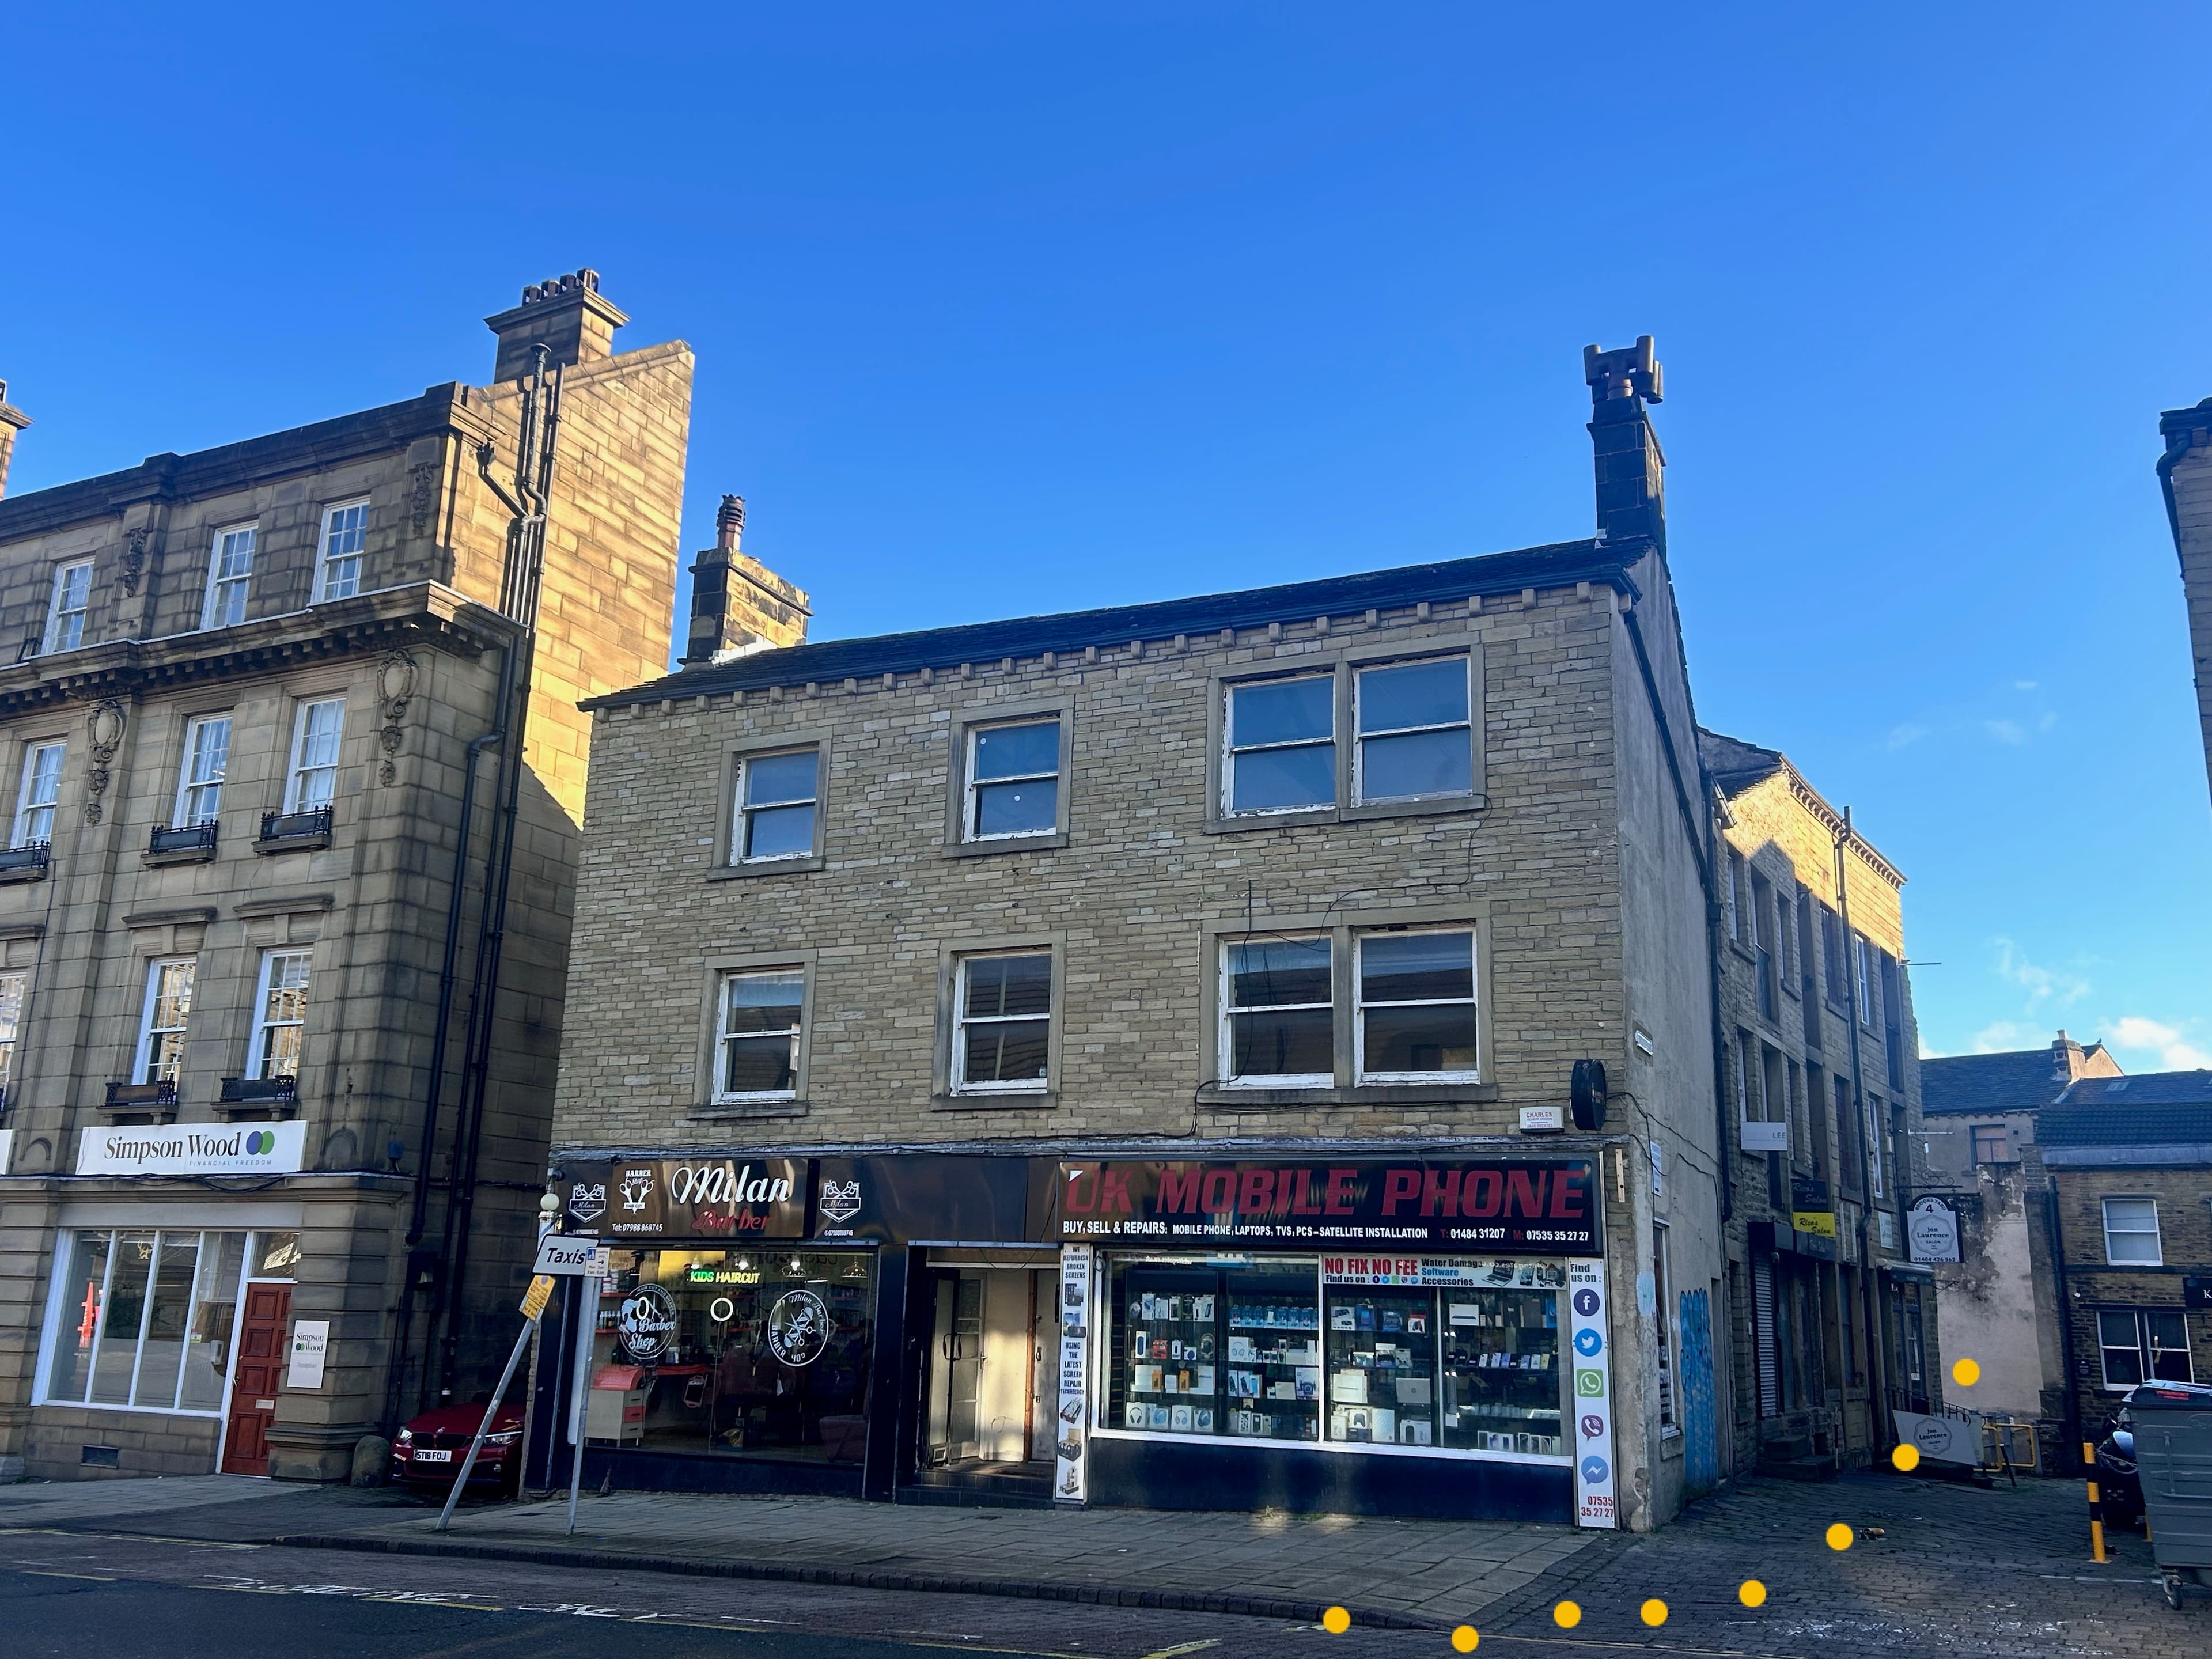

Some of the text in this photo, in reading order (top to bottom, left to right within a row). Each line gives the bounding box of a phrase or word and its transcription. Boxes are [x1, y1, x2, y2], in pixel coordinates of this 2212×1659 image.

[104, 1132, 241, 1164] Simpson Wood
[672, 1165, 791, 1204] Milan
[1065, 1169, 1586, 1218] UK MOBILE PHONE
[1805, 1193, 1828, 1203] Salon
[573, 1201, 596, 1209] Milan
[825, 1199, 849, 1208] Milan
[1915, 1198, 1946, 1210] BROOKS YARD
[1926, 1204, 1934, 1213] 4
[691, 1207, 773, 1230] Barber
[612, 1223, 622, 1231] Tel:
[1113, 1222, 1121, 1234] &
[1123, 1221, 1168, 1234] REPAIRS:
[1173, 1224, 1202, 1234] MOBILE
[1365, 1227, 1428, 1238] INSTALLATION
[1450, 1228, 1477, 1239] 01484
[1479, 1228, 1505, 1238] 31207
[1526, 1230, 1553, 1240] 07535
[1554, 1230, 1566, 1240] 35
[1567, 1231, 1577, 1240] 27
[1578, 1231, 1589, 1241] 27
[547, 1247, 586, 1264] Taxis
[1325, 1257, 1418, 1275] NO FIX NO FEE
[1421, 1258, 1448, 1267] Water
[1570, 1263, 1590, 1272] Find
[1422, 1267, 1459, 1276] Software
[690, 1271, 761, 1284] KIDS HAIRCUT
[1326, 1275, 1343, 1283] Find
[1422, 1277, 1474, 1286] Accessories
[1571, 1274, 1582, 1282] us
[1585, 1274, 1597, 1282] on
[658, 1288, 666, 1297] AND
[2203, 1289, 2212, 1298] K
[789, 1293, 826, 1334] Milan Barber
[638, 1317, 675, 1332] Barber
[296, 1332, 324, 1345] Simpson
[628, 1332, 658, 1351] Shop
[771, 1324, 786, 1358] BARBER
[305, 1343, 324, 1352] Wood
[1063, 1370, 1082, 1378] SCREEN
[1588, 1495, 1613, 1506] 07535
[1581, 1506, 1613, 1517] 35 27 27
